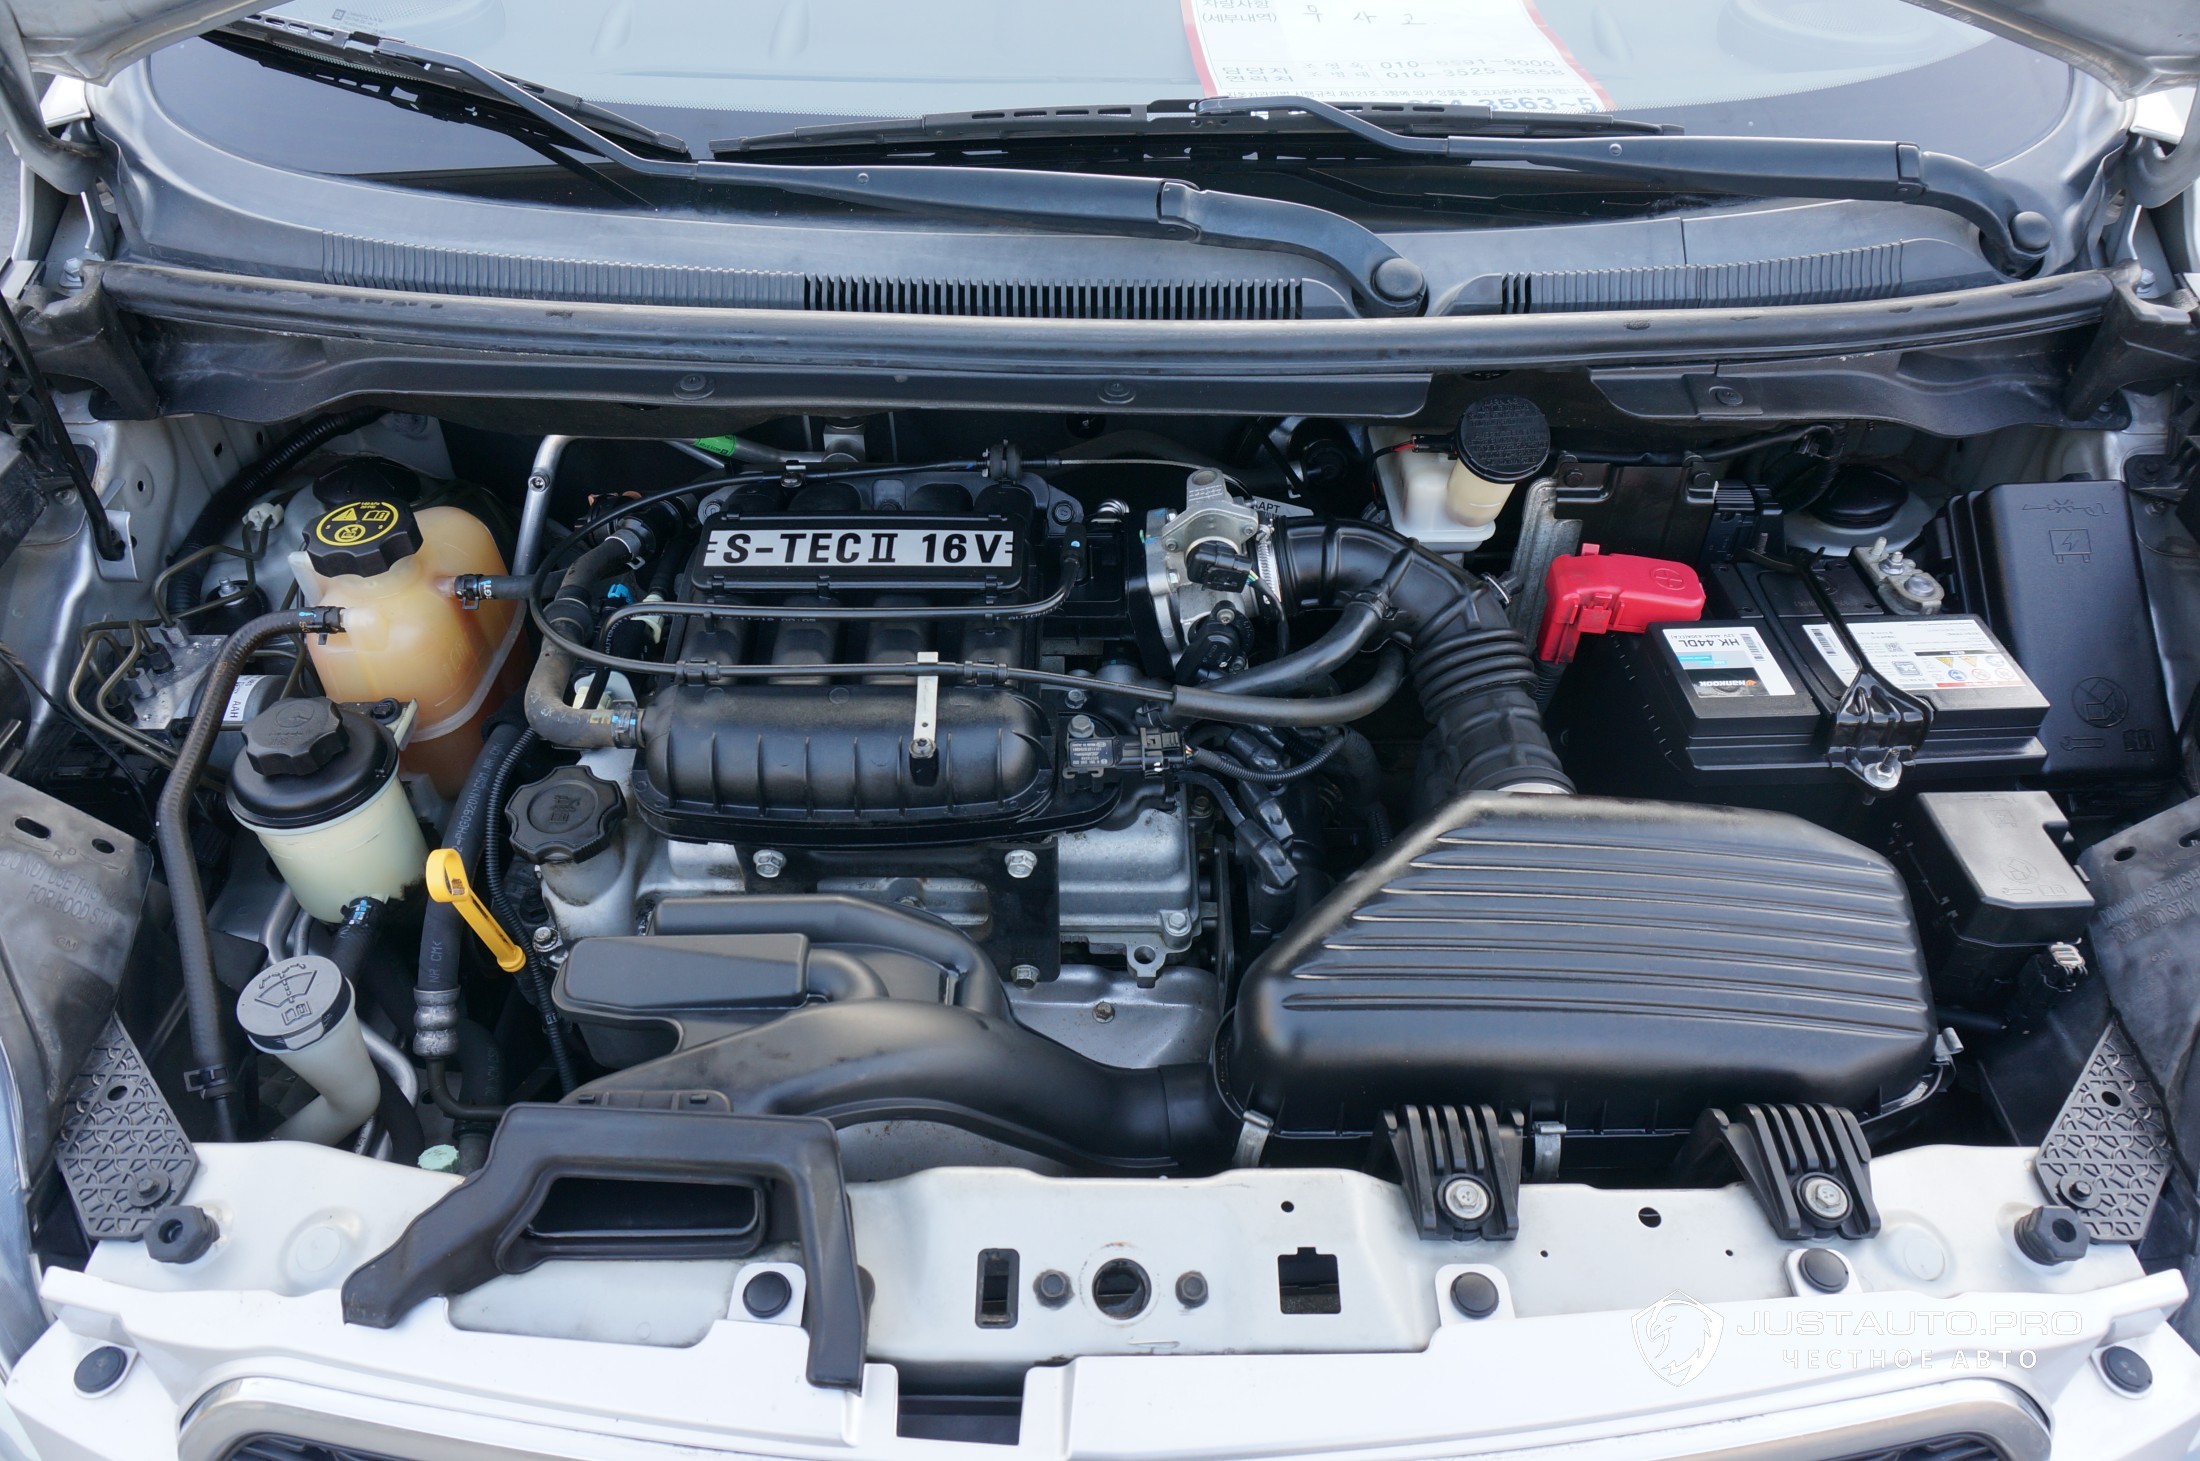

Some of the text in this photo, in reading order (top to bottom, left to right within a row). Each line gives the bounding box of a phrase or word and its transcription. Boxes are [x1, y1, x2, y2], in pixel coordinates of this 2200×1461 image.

[921, 532, 1003, 564] 16V
[1679, 638, 1740, 648] HK 44DL
[23, 859, 48, 881] NOT
[47, 868, 75, 890] USE
[73, 875, 101, 900] THIS
[2143, 884, 2167, 907] USE
[2161, 872, 2193, 898] THIS
[27, 883, 119, 930] FOR HOOD STAY
[2133, 907, 2168, 932] HOOD
[2166, 896, 2200, 921] STAY
